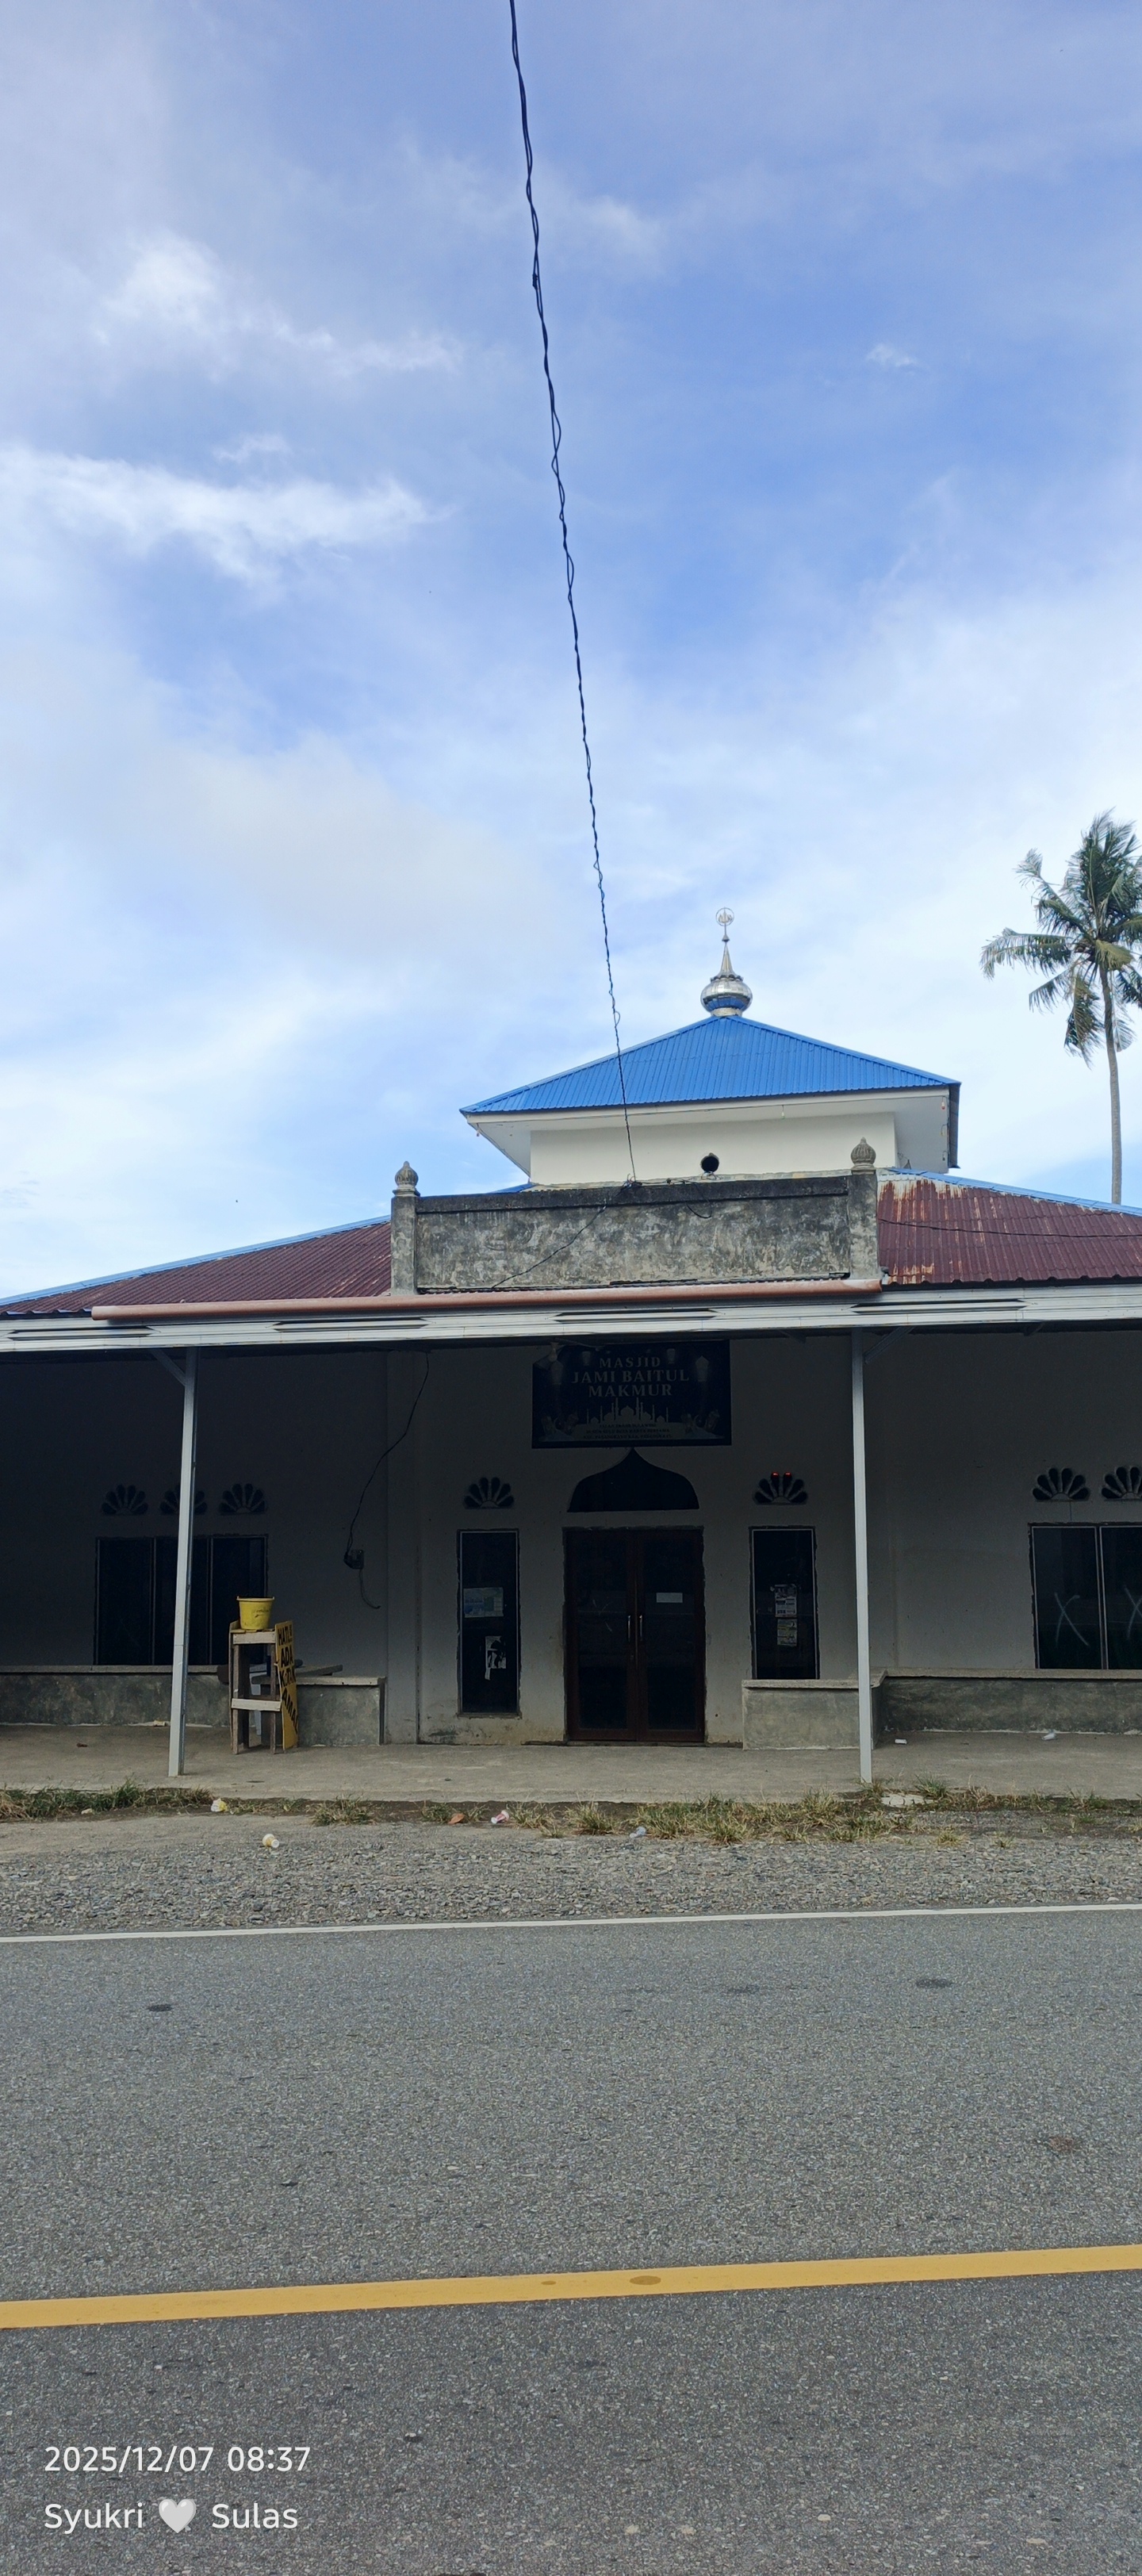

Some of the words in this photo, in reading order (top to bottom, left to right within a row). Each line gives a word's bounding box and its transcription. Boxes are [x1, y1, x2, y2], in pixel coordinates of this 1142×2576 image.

[599, 1356, 661, 1369] MASJID
[571, 1370, 615, 1384] JAMI
[621, 1369, 689, 1383] BAITUL
[588, 1383, 673, 1397] MAKMUR
[281, 1645, 293, 1668] ADA
[281, 1687, 298, 1735] AMAL
